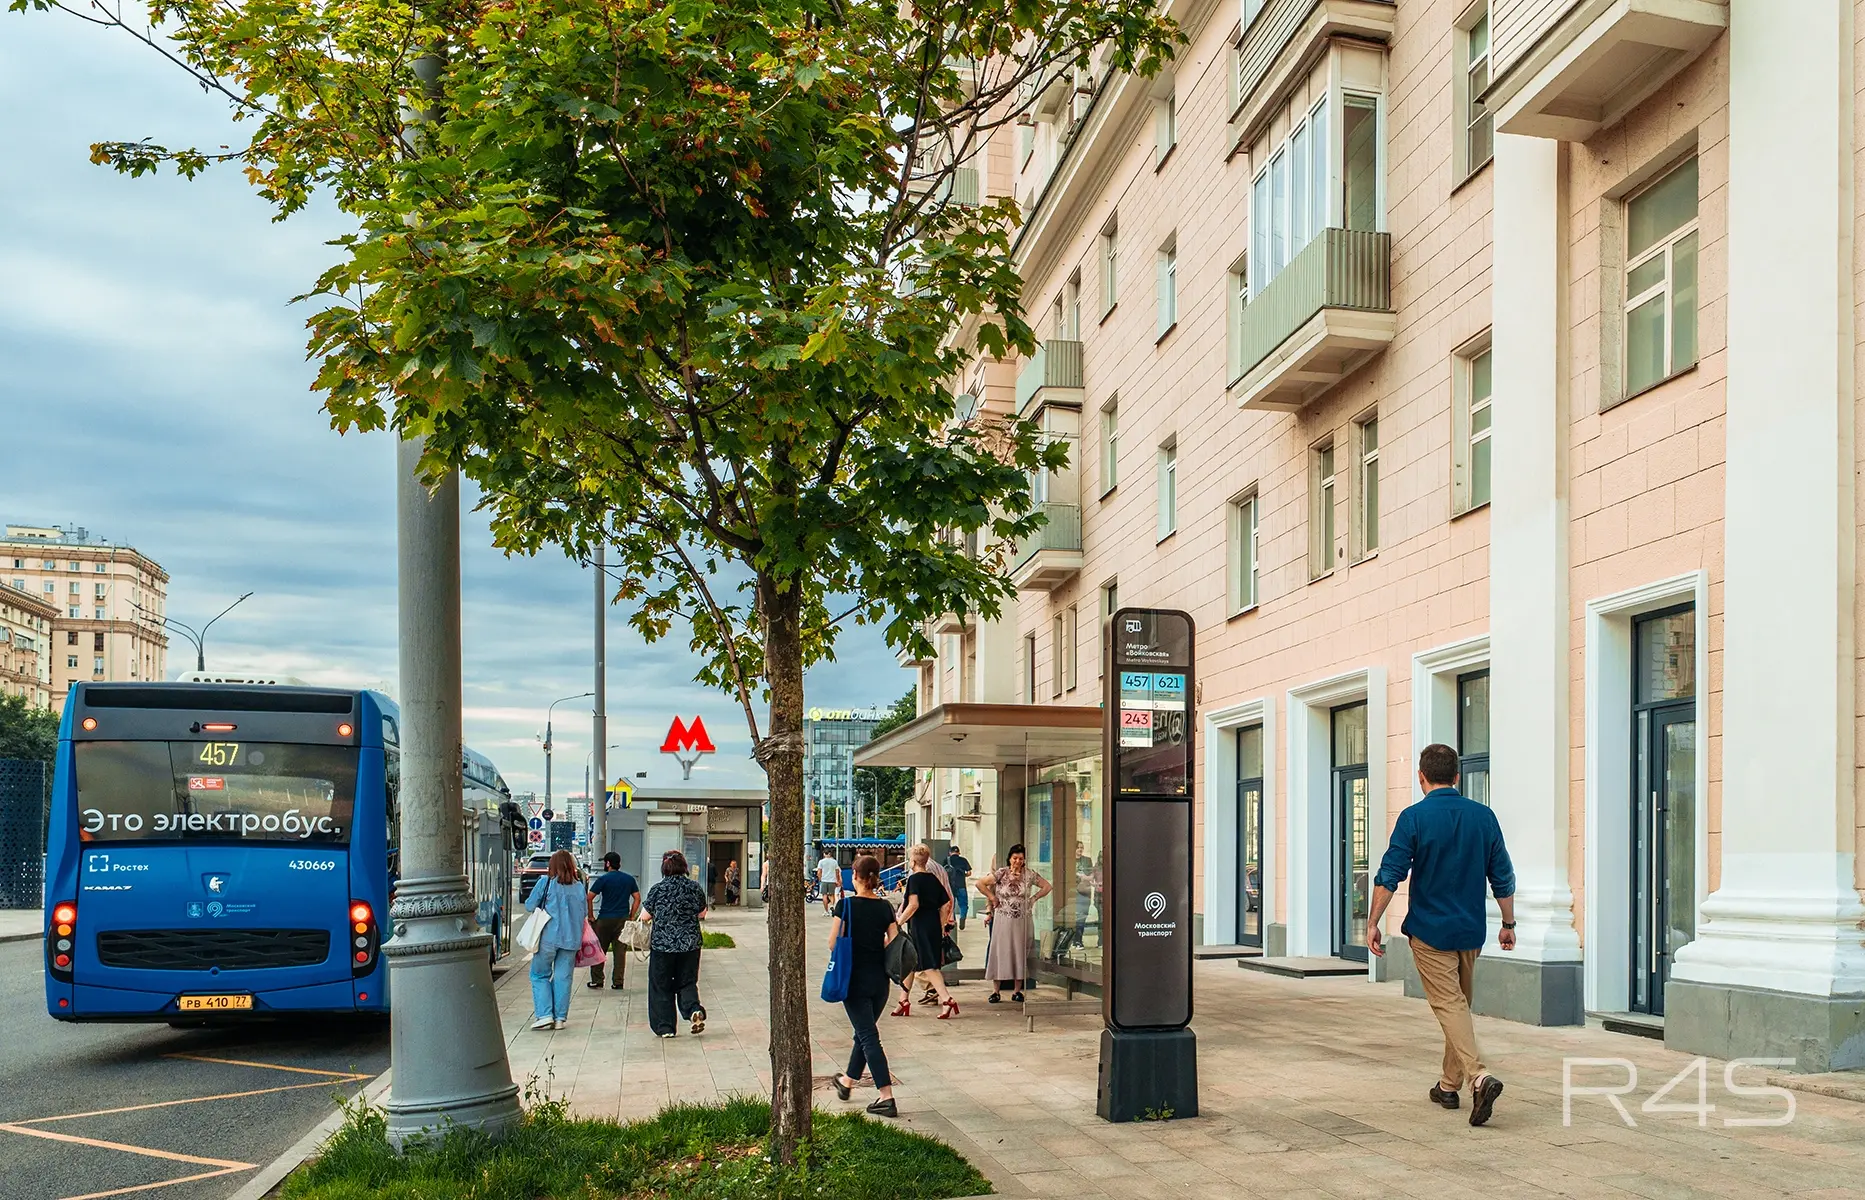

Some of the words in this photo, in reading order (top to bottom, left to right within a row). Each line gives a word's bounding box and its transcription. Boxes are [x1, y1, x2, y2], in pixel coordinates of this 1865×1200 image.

[1125, 675, 1148, 687] 457
[1159, 676, 1180, 689] 621
[1125, 713, 1148, 725] 243
[200, 743, 239, 766] 457
[82, 808, 144, 832] Это
[153, 808, 341, 838] электробус.
[113, 863, 149, 872] Ростех
[289, 860, 335, 871] 430669
[1134, 921, 1176, 929] Московский
[1138, 930, 1173, 938] транспорт
[206, 997, 229, 1008] 410
[235, 996, 247, 1005] 77
